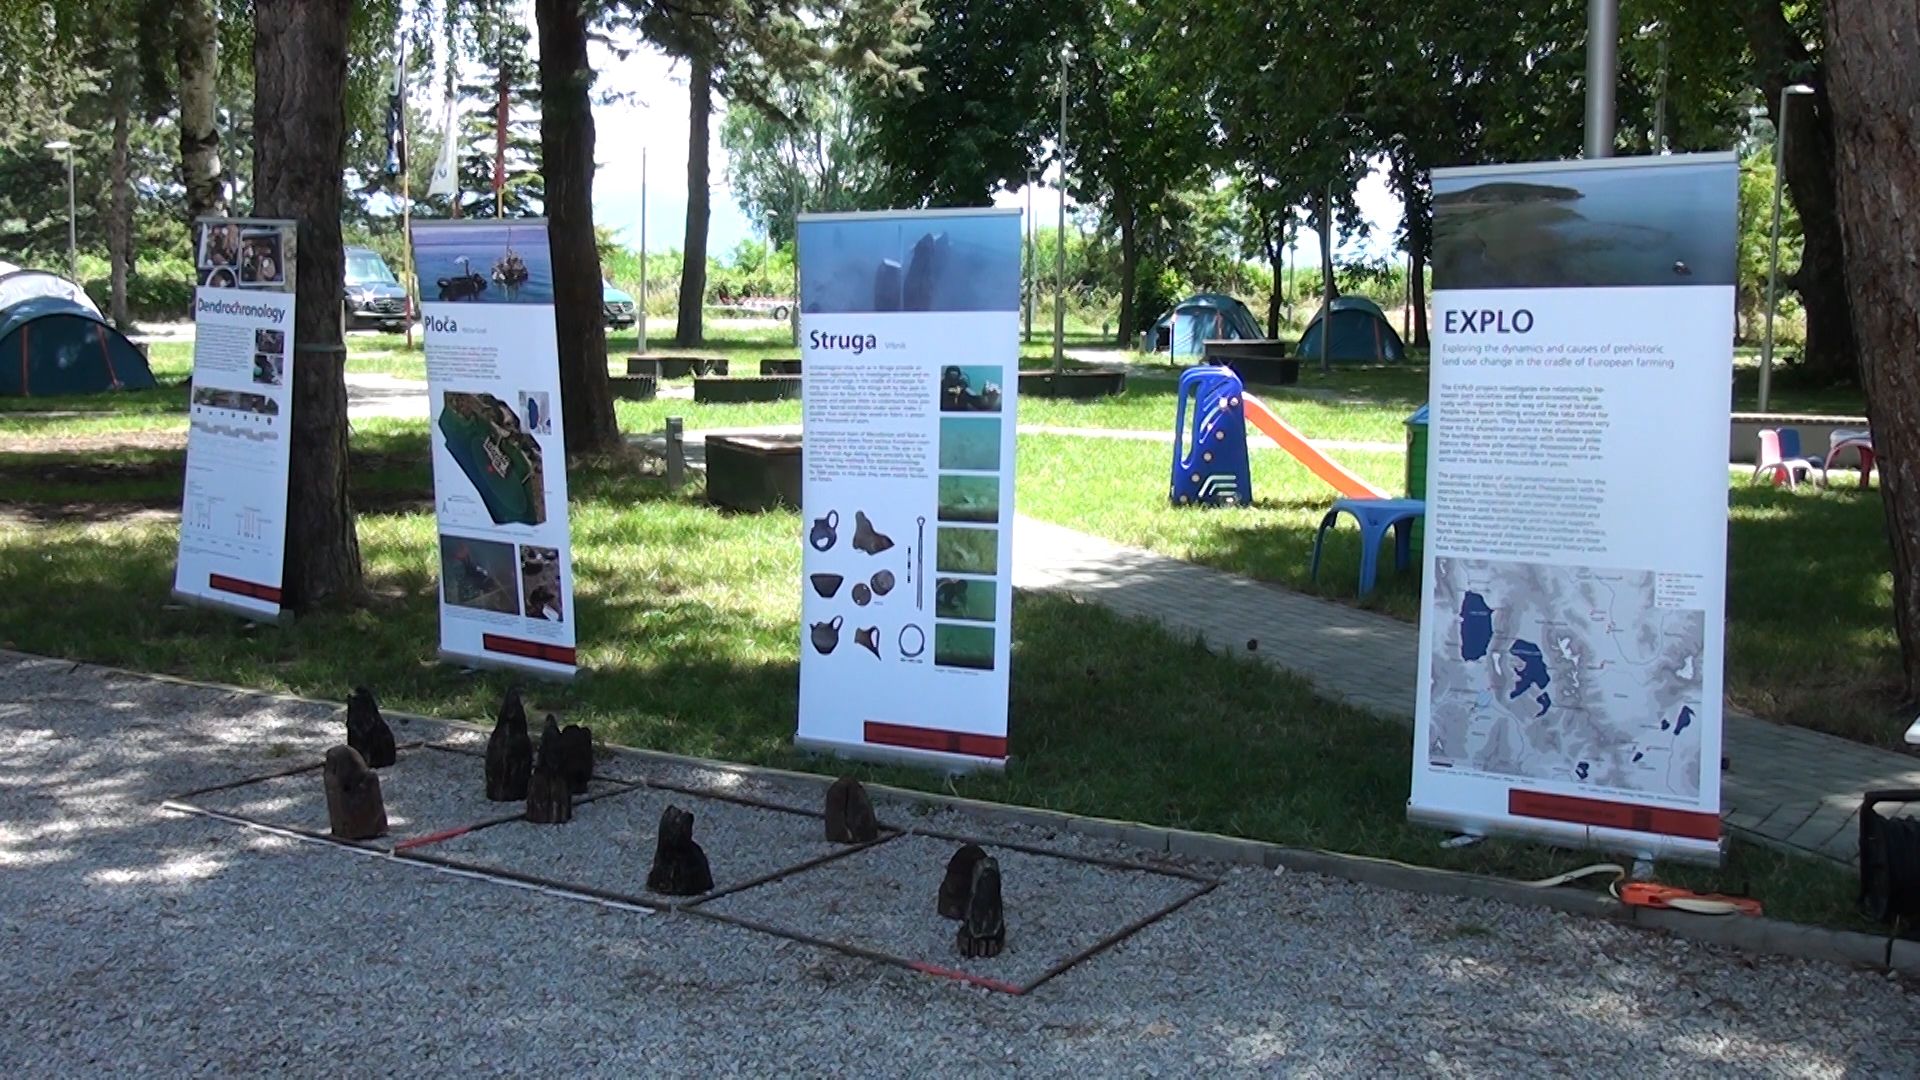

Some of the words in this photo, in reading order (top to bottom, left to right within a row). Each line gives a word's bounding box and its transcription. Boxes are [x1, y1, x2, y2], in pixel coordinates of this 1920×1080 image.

[198, 298, 285, 323] Dendrochronology
[424, 315, 457, 333] Ploča
[1445, 309, 1534, 334] EXPLO
[810, 330, 877, 355] Struga
[1442, 344, 1481, 354] Exploring
[1485, 344, 1499, 353] the
[1502, 344, 1543, 355] dynamics
[1547, 344, 1563, 353] and
[1600, 344, 1610, 353] of
[1614, 344, 1663, 355] prehistoric
[1442, 358, 1459, 366] land
[1480, 358, 1512, 367] change
[1515, 358, 1523, 366] in
[1526, 358, 1541, 366] the
[1544, 358, 1571, 367] cradle
[1575, 358, 1585, 367] of
[1588, 358, 1633, 368] European
[1636, 358, 1674, 369] farming
